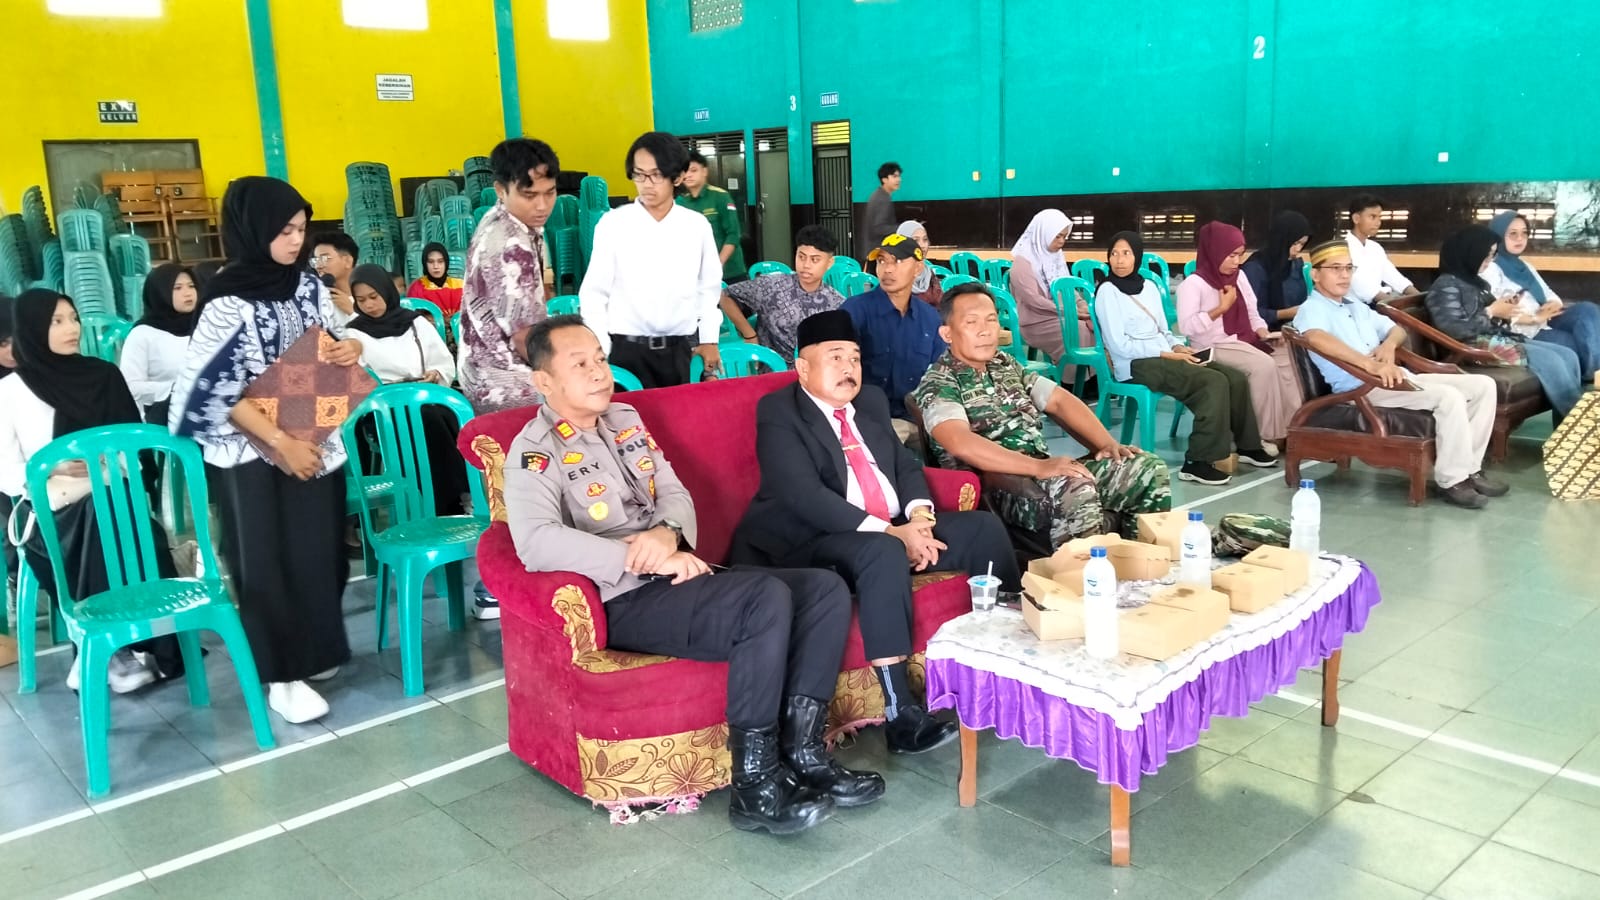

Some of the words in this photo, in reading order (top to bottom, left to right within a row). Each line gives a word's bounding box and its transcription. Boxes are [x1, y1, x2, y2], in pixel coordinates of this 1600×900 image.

[1253, 35, 1265, 59] 2
[789, 95, 797, 111] 3
[567, 462, 600, 481] ERY
